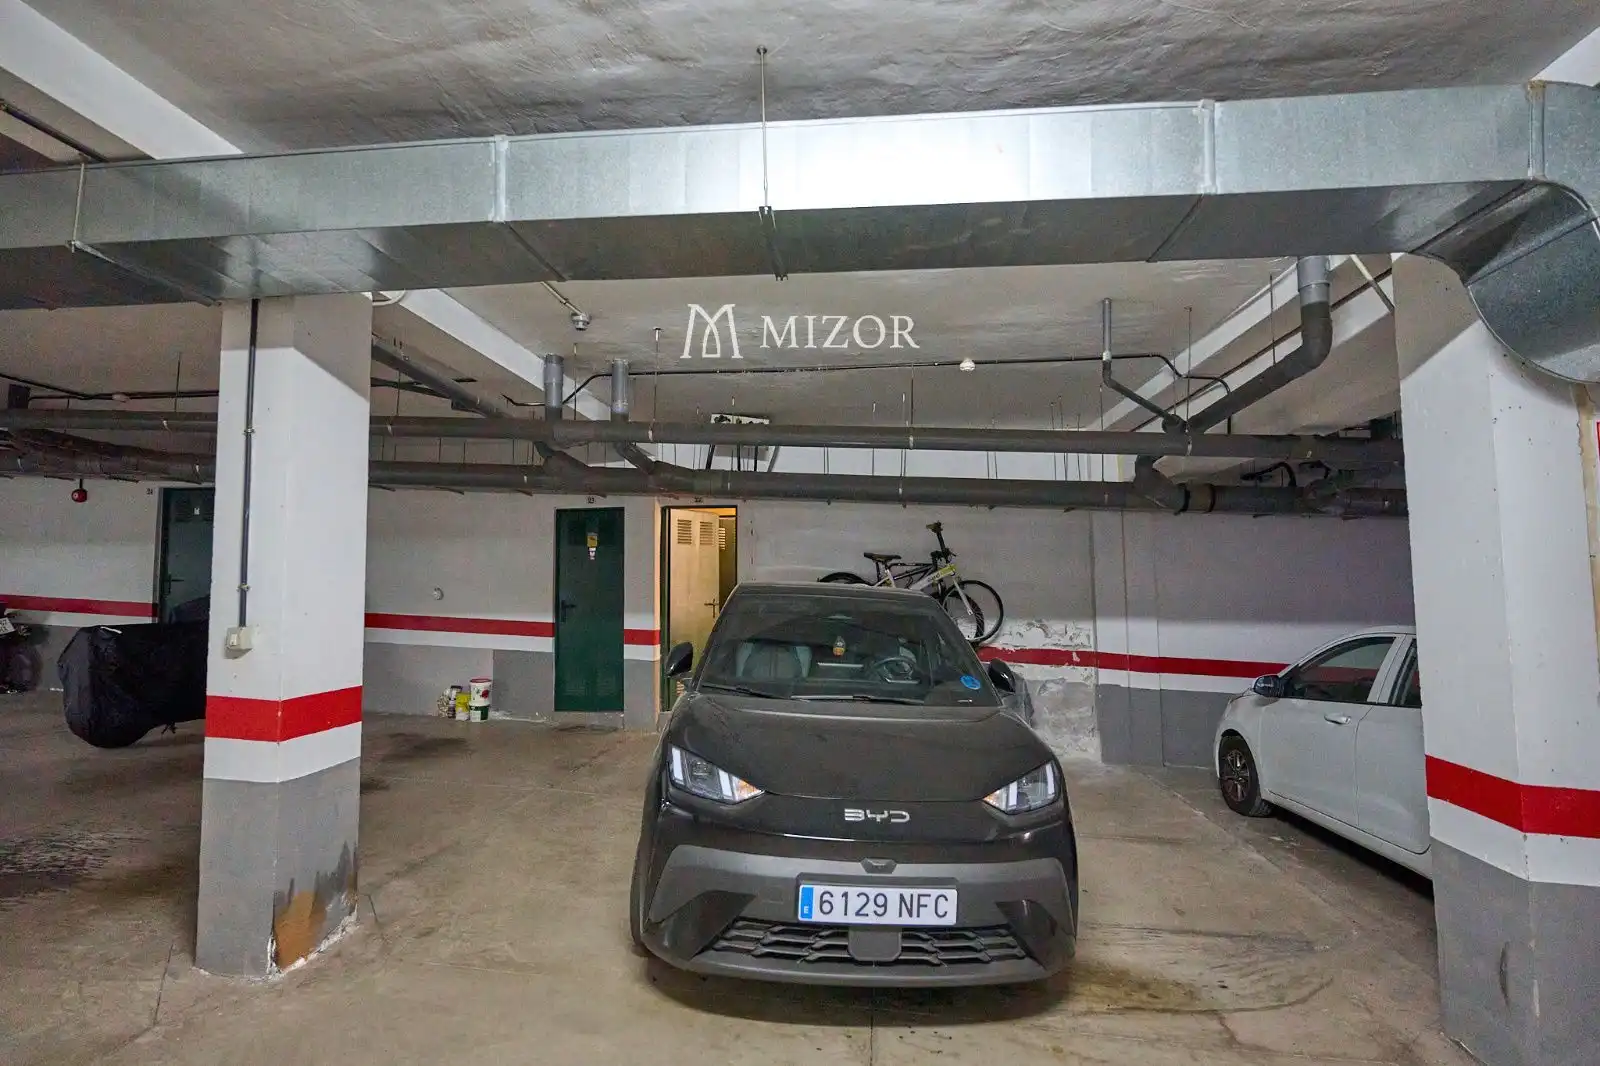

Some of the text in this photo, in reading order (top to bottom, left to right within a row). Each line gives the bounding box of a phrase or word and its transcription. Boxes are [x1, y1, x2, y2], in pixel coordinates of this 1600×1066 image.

[844, 808, 910, 823] BYD
[819, 890, 888, 917] 6129
[898, 893, 949, 919] NFC
